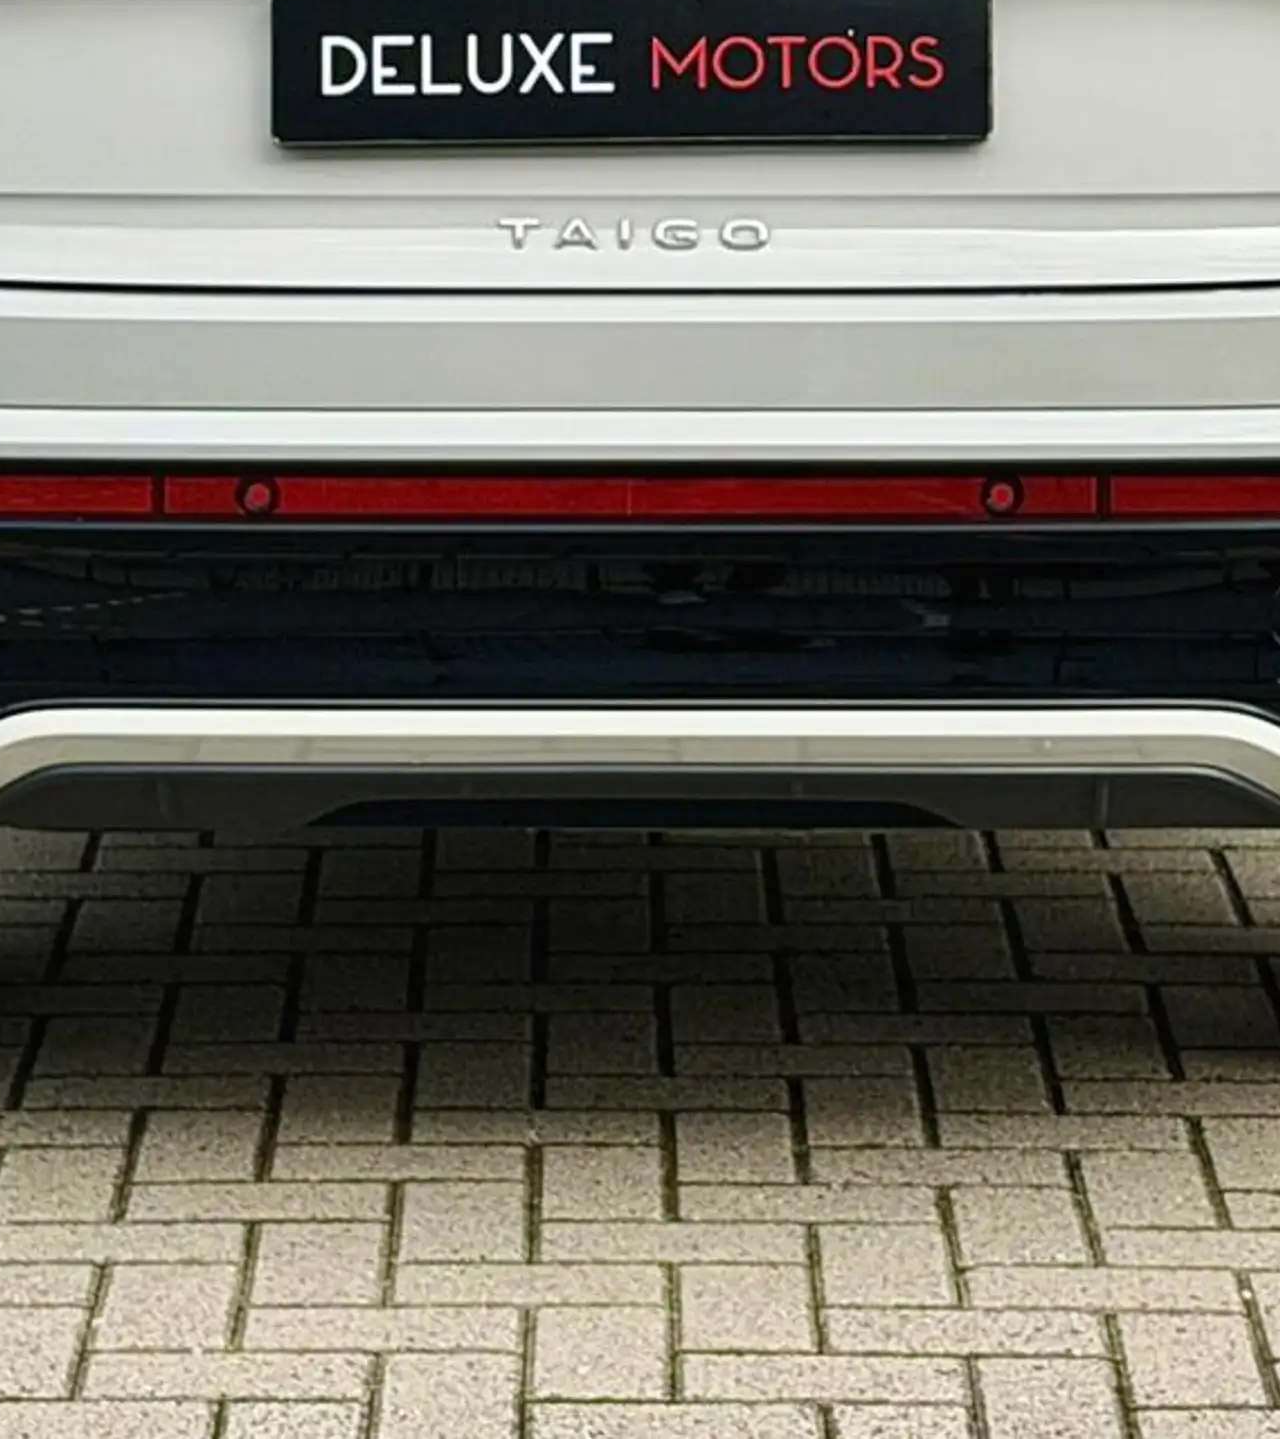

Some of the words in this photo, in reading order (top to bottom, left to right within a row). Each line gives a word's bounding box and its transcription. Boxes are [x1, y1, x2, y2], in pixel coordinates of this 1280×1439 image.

[320, 32, 615, 96] DELUXE
[650, 34, 945, 91] MOTORS
[497, 217, 772, 252] TAIGO
